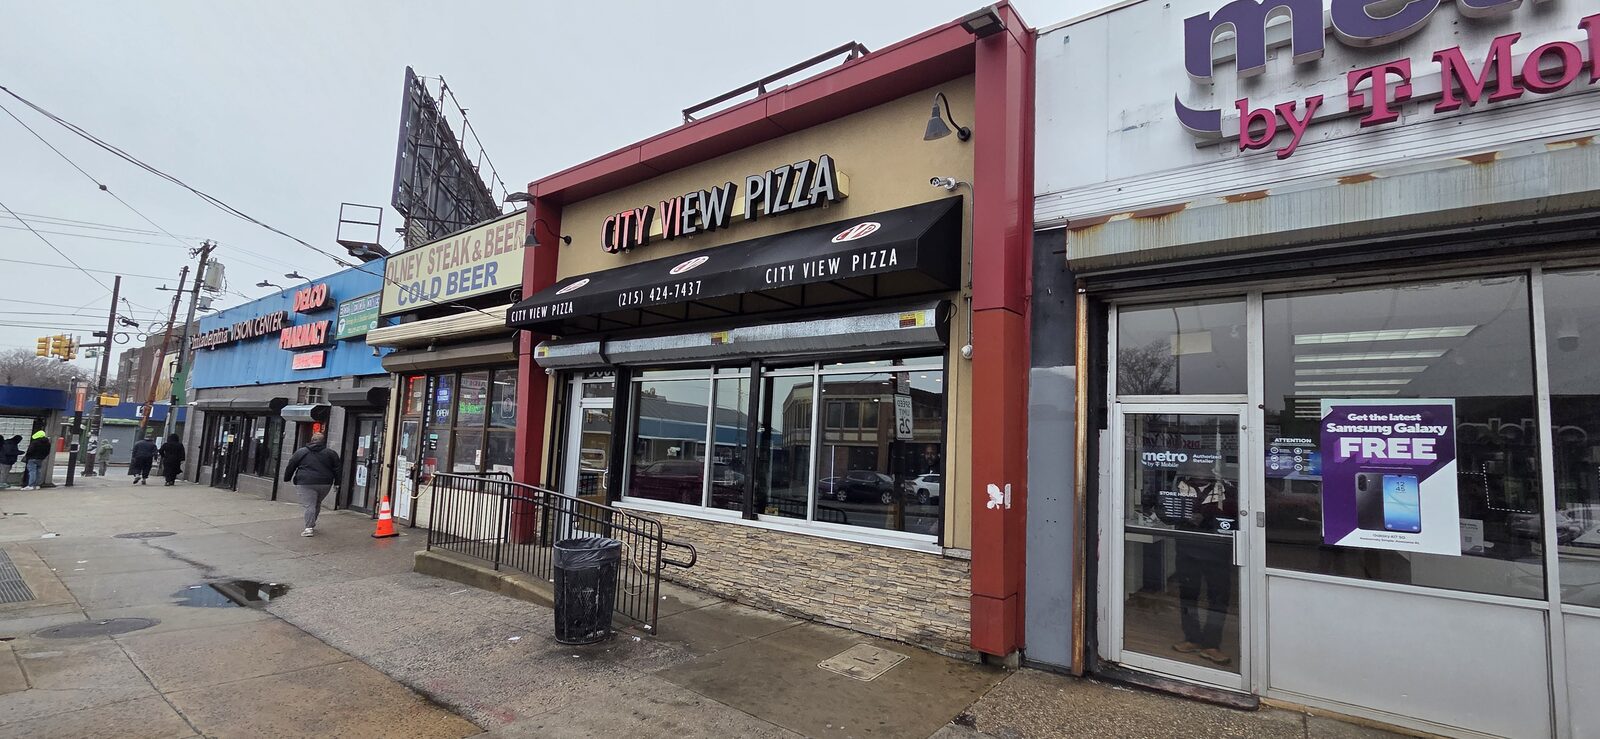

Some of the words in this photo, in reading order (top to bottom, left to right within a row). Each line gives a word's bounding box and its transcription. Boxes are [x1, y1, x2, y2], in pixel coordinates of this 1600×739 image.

[1235, 95, 1324, 160] by
[1347, 57, 1412, 128] T
[601, 205, 653, 254] CITY
[659, 181, 737, 240] VIEW
[744, 154, 838, 221] PIZZA
[386, 251, 424, 286] OLNEY
[427, 235, 472, 275] STEAK
[472, 239, 482, 262] &
[484, 218, 526, 259] BEER
[765, 264, 795, 284] CITY
[802, 257, 841, 279] VIEW
[852, 248, 898, 272] PIZZA
[293, 282, 328, 313] DELCO
[398, 275, 442, 306] COLD
[446, 260, 498, 297] BEER
[618, 289, 644, 307] (215)
[649, 280, 702, 302] 424-7437
[231, 319, 254, 342] VISION
[254, 311, 283, 336] CENTER
[511, 308, 526, 322] CITY
[529, 305, 548, 320] VIEW
[551, 301, 573, 316] PIZZA
[279, 320, 330, 349] PHARMACY
[1326, 423, 1392, 435] Samsung
[1394, 423, 1448, 435] Galaxy
[1369, 413, 1388, 421] the
[1389, 413, 1422, 421] latest
[1142, 450, 1188, 462] metro
[1340, 437, 1437, 460] FREE
